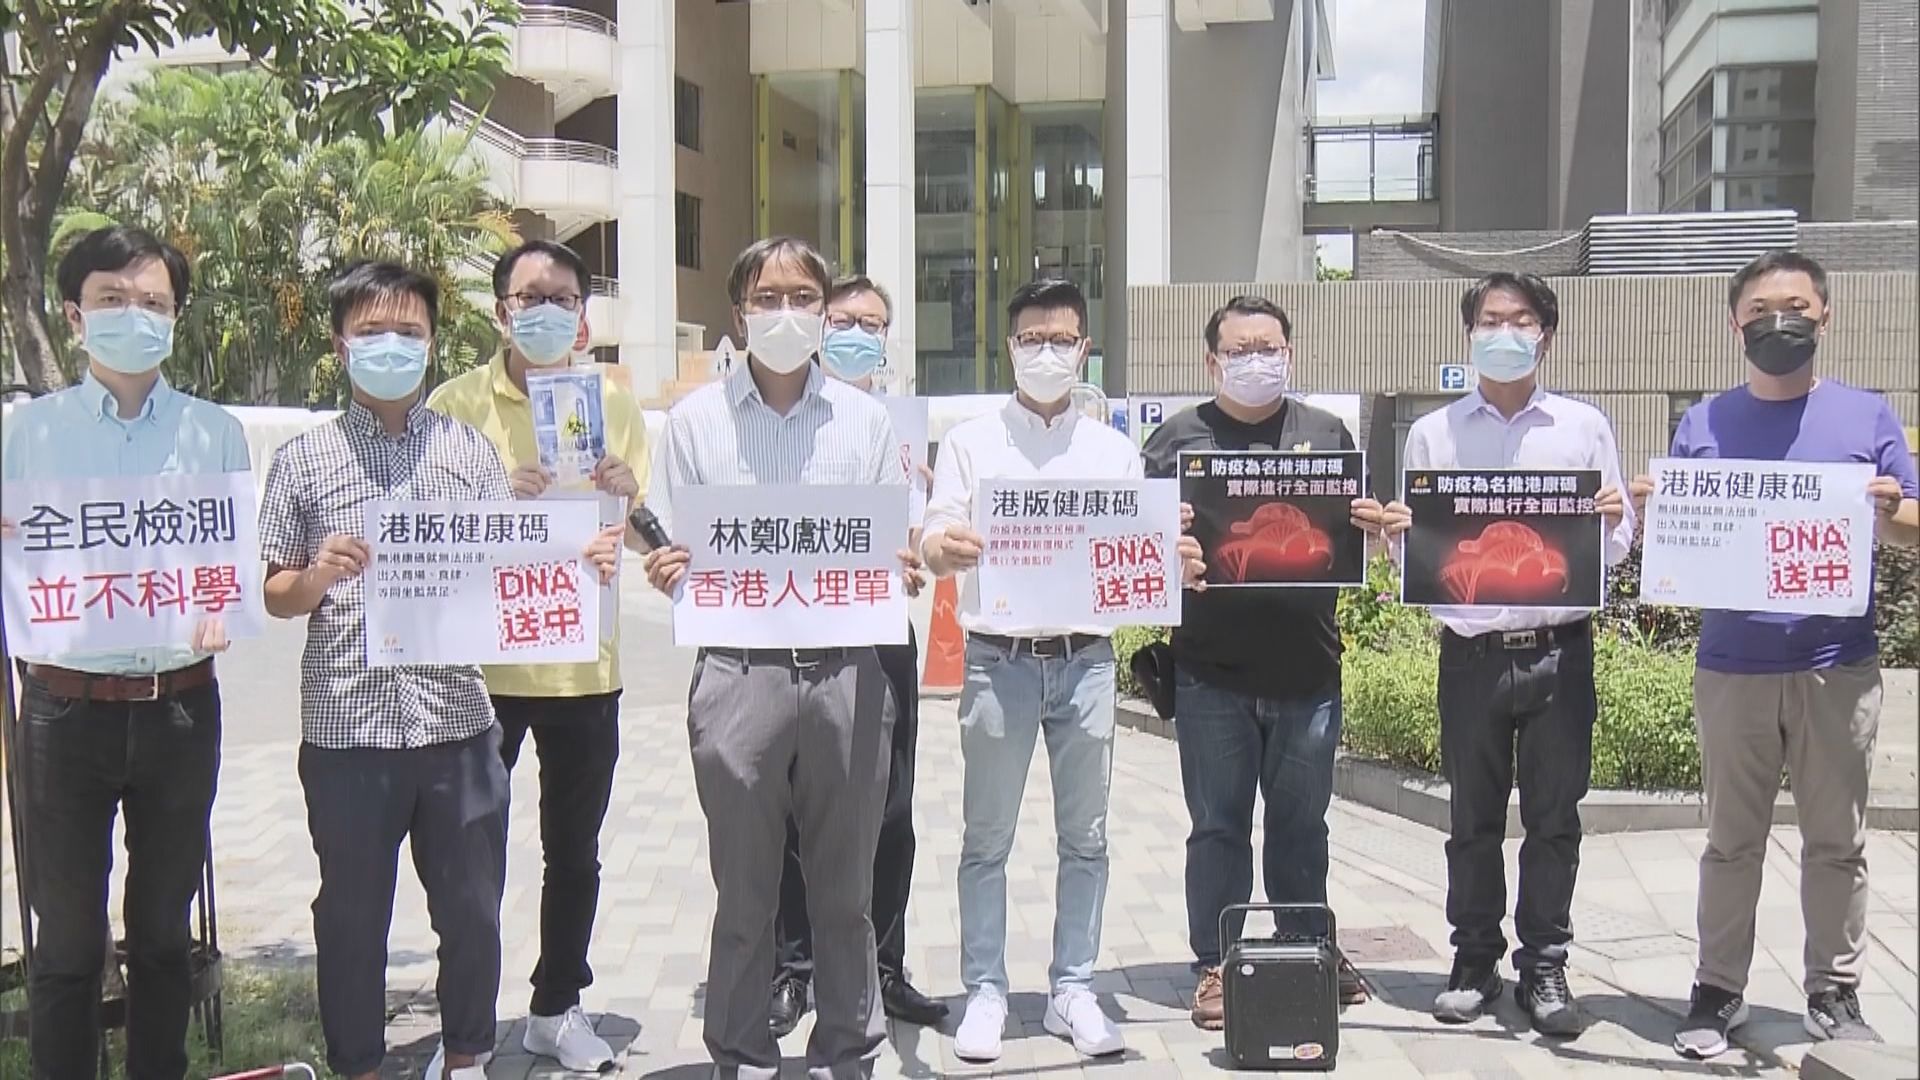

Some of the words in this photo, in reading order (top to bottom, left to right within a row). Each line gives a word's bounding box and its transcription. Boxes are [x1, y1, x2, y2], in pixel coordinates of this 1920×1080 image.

[1211, 458, 1343, 476] 防疫為名推港康碼
[1227, 478, 1358, 496] 實際進行全面監控
[1438, 475, 1577, 494] 防疫為名推港康碼
[1660, 469, 1822, 501] 港版健康碼
[992, 489, 1138, 517] 港版健康碼
[1454, 497, 1595, 515] 實際進行全面監控
[20, 497, 236, 551] 全民檢測
[378, 512, 549, 543] 港版健康碼
[709, 516, 871, 555] 林鄭獻媚
[1770, 524, 1848, 553] DNA
[1094, 538, 1162, 569] DNA
[499, 565, 576, 600] DNA
[689, 569, 891, 608] 香港人埋單
[1098, 572, 1164, 607] 送中
[1773, 560, 1849, 594] 送中
[28, 565, 241, 623] 並不科學
[503, 604, 580, 644] 送中
